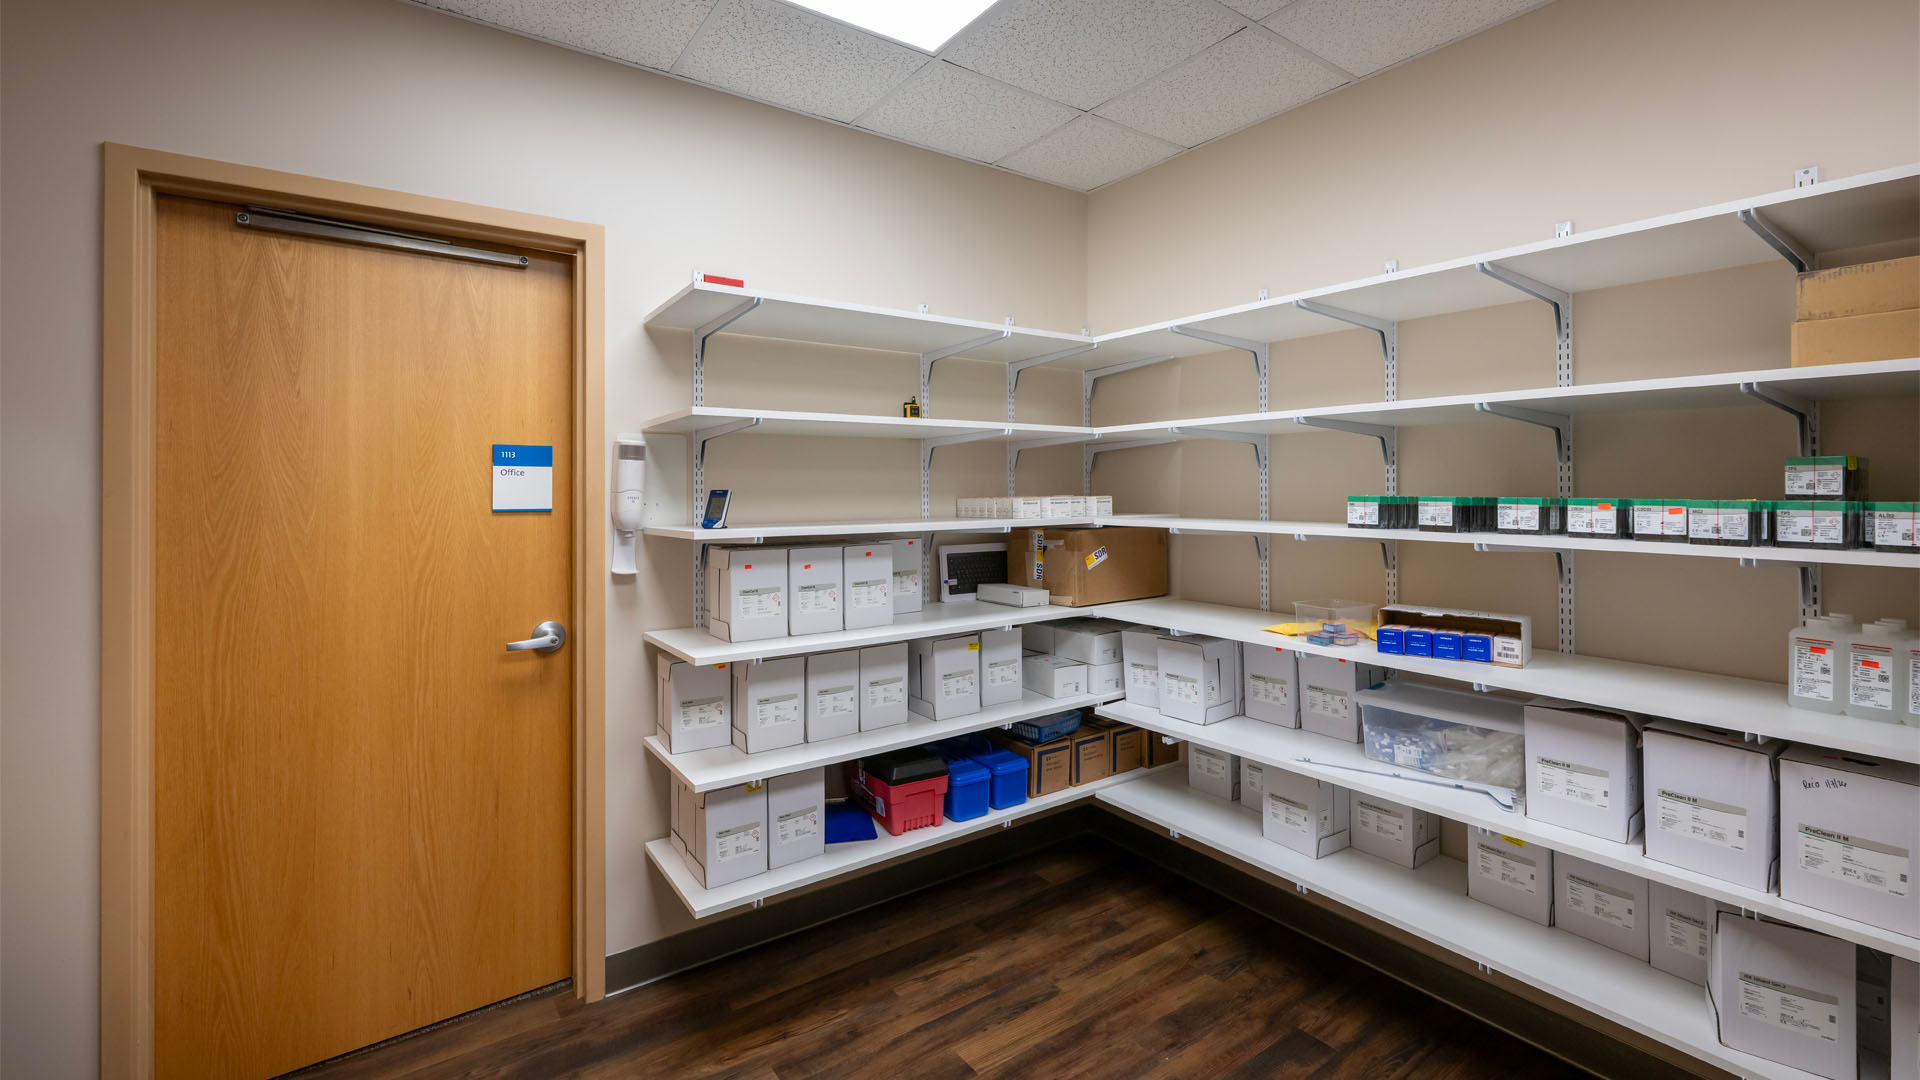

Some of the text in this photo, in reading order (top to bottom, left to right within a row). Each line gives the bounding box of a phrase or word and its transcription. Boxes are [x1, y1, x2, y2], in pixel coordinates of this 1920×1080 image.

[1094, 547, 1107, 560] SDR
[1541, 757, 1562, 767] PreClean
[1661, 790, 1687, 801] PreClean
[1804, 826, 1836, 839] PreClean
